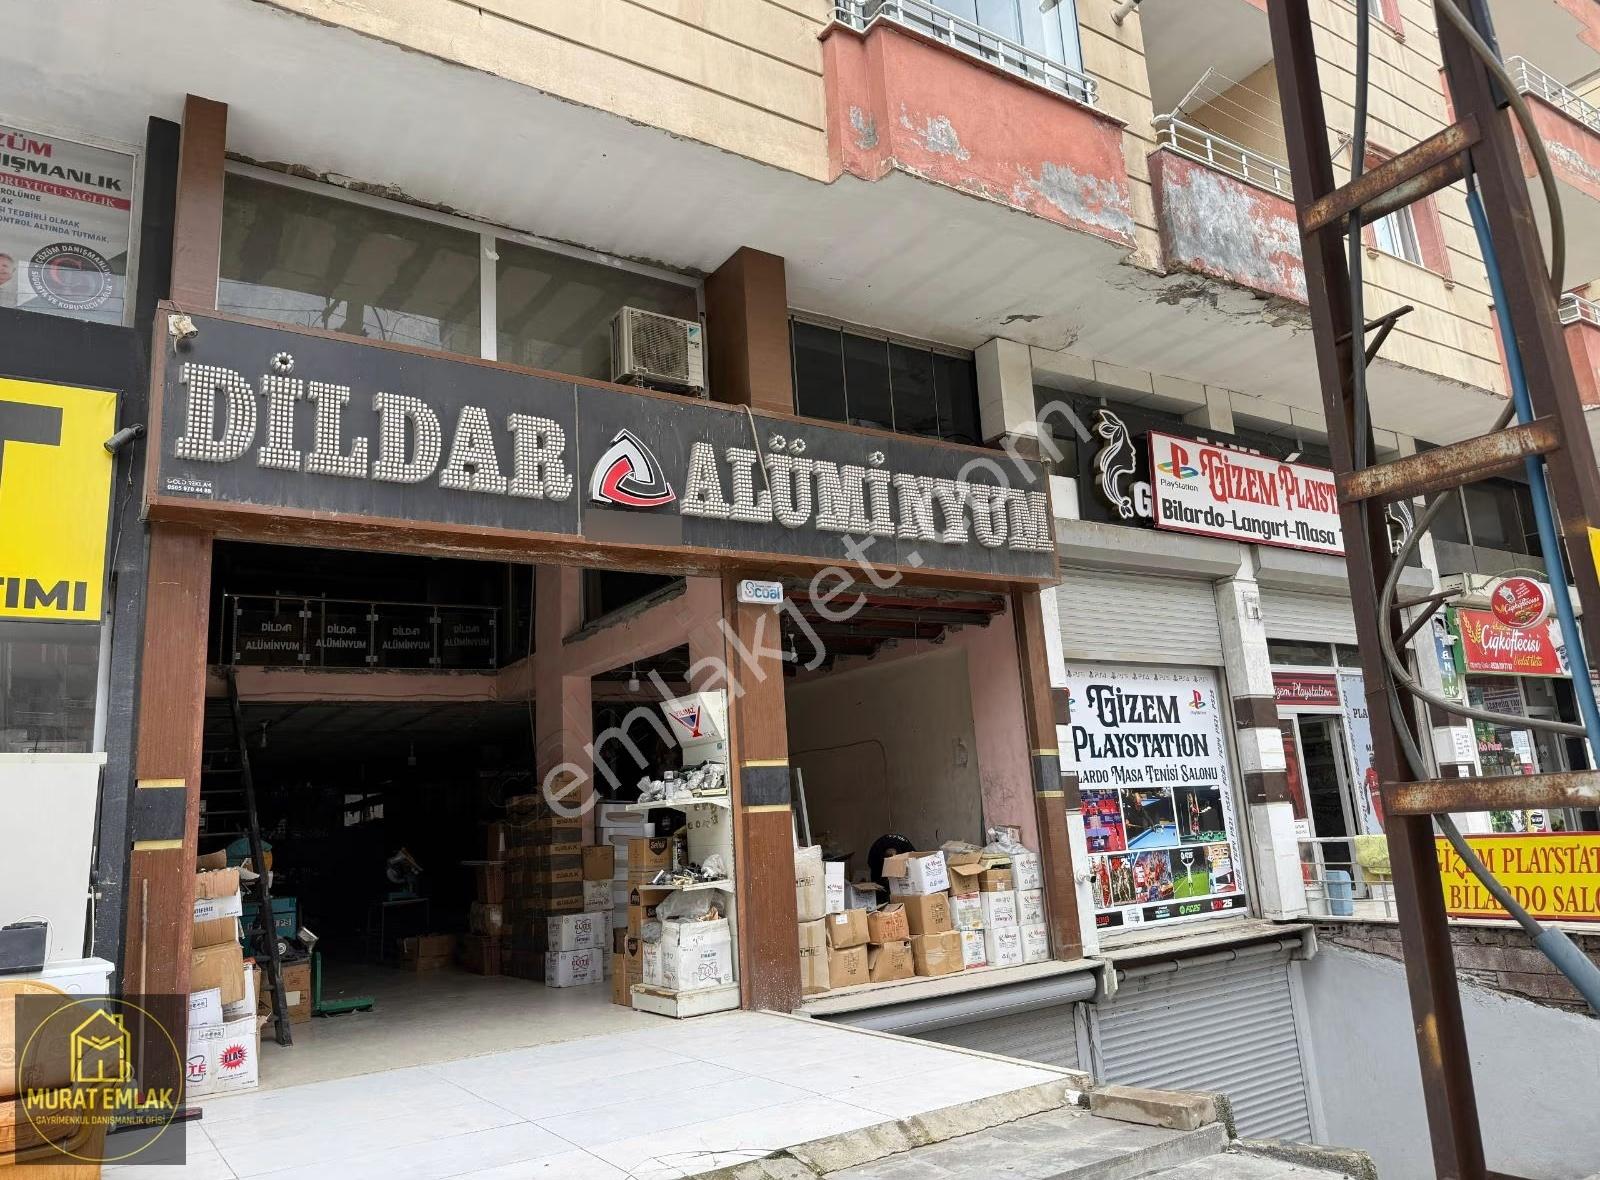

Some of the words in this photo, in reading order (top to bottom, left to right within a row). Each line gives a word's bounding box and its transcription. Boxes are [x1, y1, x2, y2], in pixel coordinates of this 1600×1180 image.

[0, 153, 122, 192] IŞMANLIK
[65, 189, 115, 208] SAĞLIK
[34, 222, 70, 235] ALTINDA
[49, 216, 80, 228] OLMAK
[174, 351, 574, 500] DİLDAR
[680, 432, 1055, 553] ALÜMİNYUM
[1160, 478, 1199, 492] PlayStation
[1278, 464, 1339, 515] PLAYST
[245, 639, 300, 651] ALÜMİNYUM
[315, 637, 366, 649] ALÜMİNYUM
[1292, 682, 1333, 700] Playstation
[1086, 684, 1181, 728] GİZEM
[1072, 725, 1210, 762] PLAYSTATION
